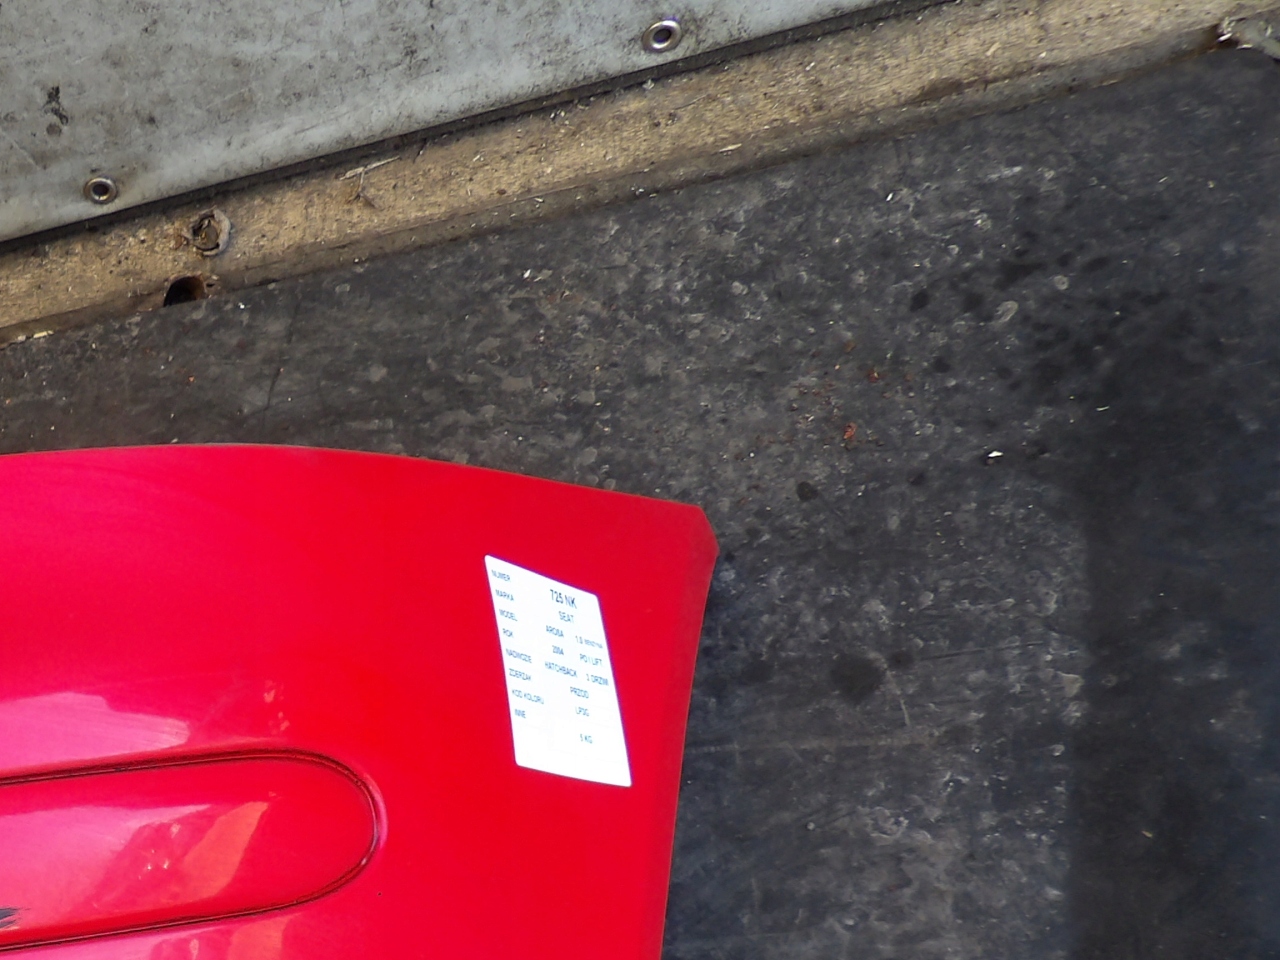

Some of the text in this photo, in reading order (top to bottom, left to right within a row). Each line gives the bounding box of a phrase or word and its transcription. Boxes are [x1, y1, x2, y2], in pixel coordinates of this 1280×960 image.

[549, 588, 577, 609] 725 NK
[558, 610, 575, 624] SEAT
[544, 660, 578, 679] HATCHBACK
